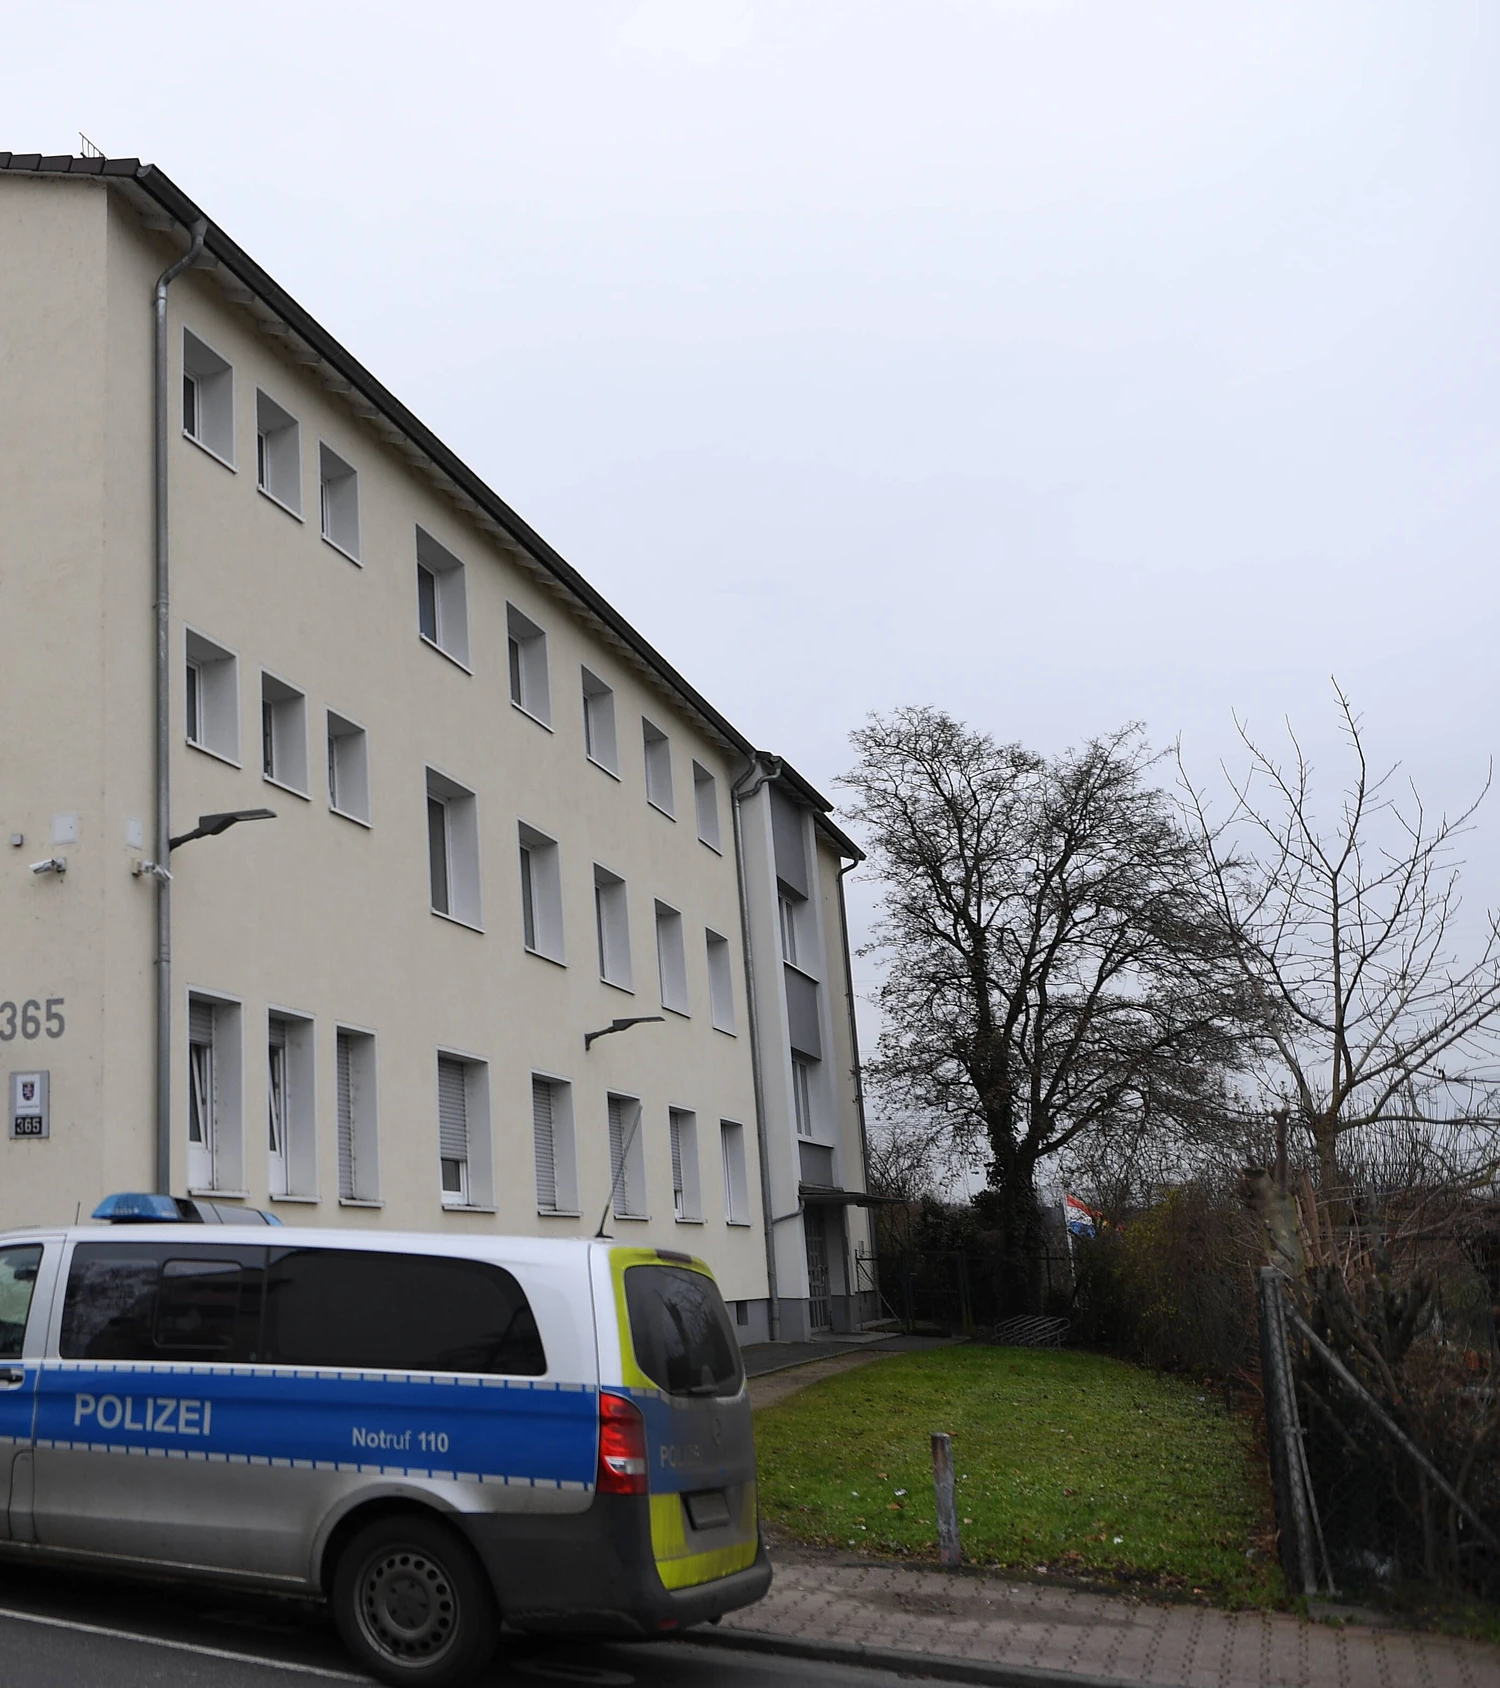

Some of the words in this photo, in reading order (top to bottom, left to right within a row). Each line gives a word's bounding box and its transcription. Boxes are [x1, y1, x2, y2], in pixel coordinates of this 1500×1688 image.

[17, 1118, 40, 1134] 365
[73, 1393, 212, 1436] POLIZEI
[352, 1427, 412, 1451] Notruf
[418, 1432, 450, 1454] 110
